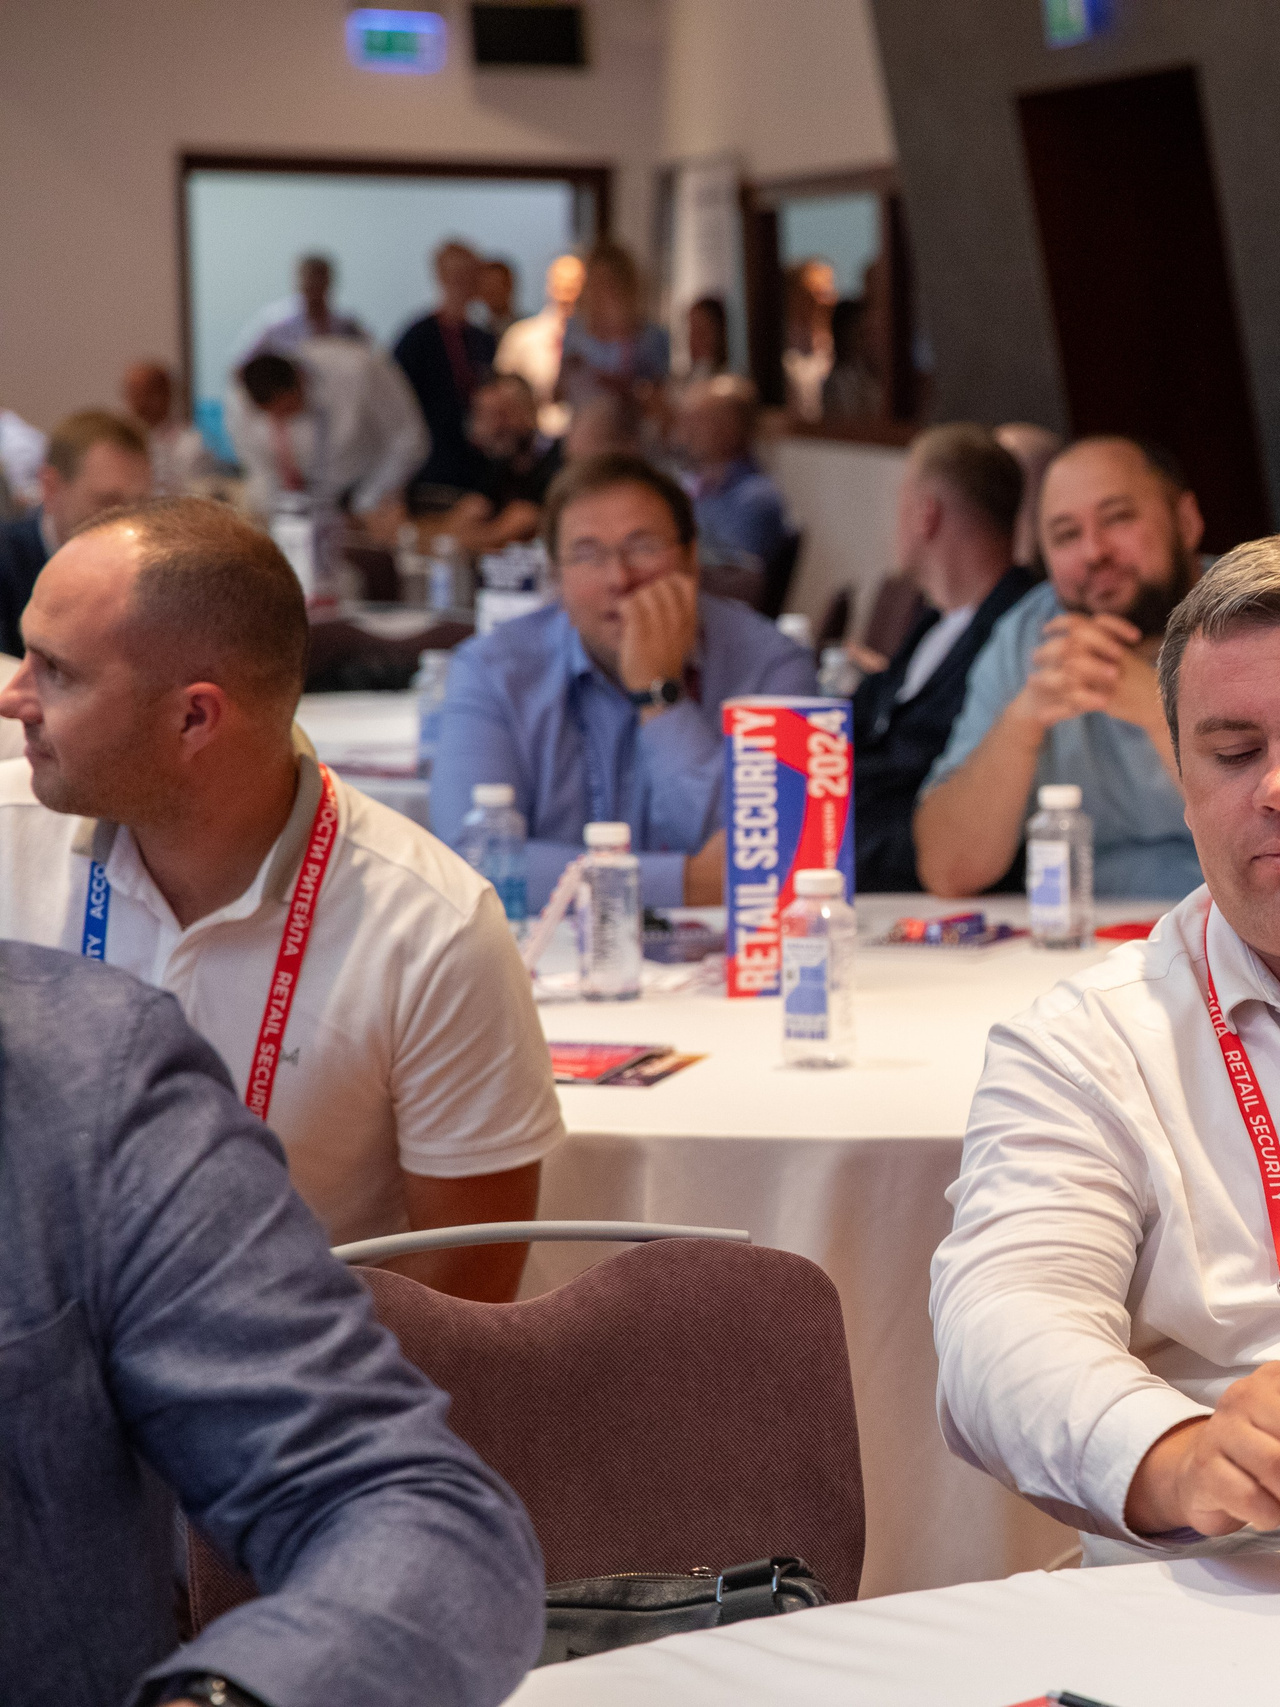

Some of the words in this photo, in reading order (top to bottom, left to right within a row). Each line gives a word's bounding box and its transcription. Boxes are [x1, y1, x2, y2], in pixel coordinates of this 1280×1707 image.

[732, 708, 778, 870] SECURITY
[807, 710, 849, 799] 2024
[90, 864, 106, 920] АССО
[284, 861, 321, 957] РИТЕЙЛА
[735, 875, 779, 991] RETAIL
[263, 970, 293, 1038] RETAIL
[250, 1042, 276, 1116] SECURI
[1225, 1049, 1258, 1112] RETAIL
